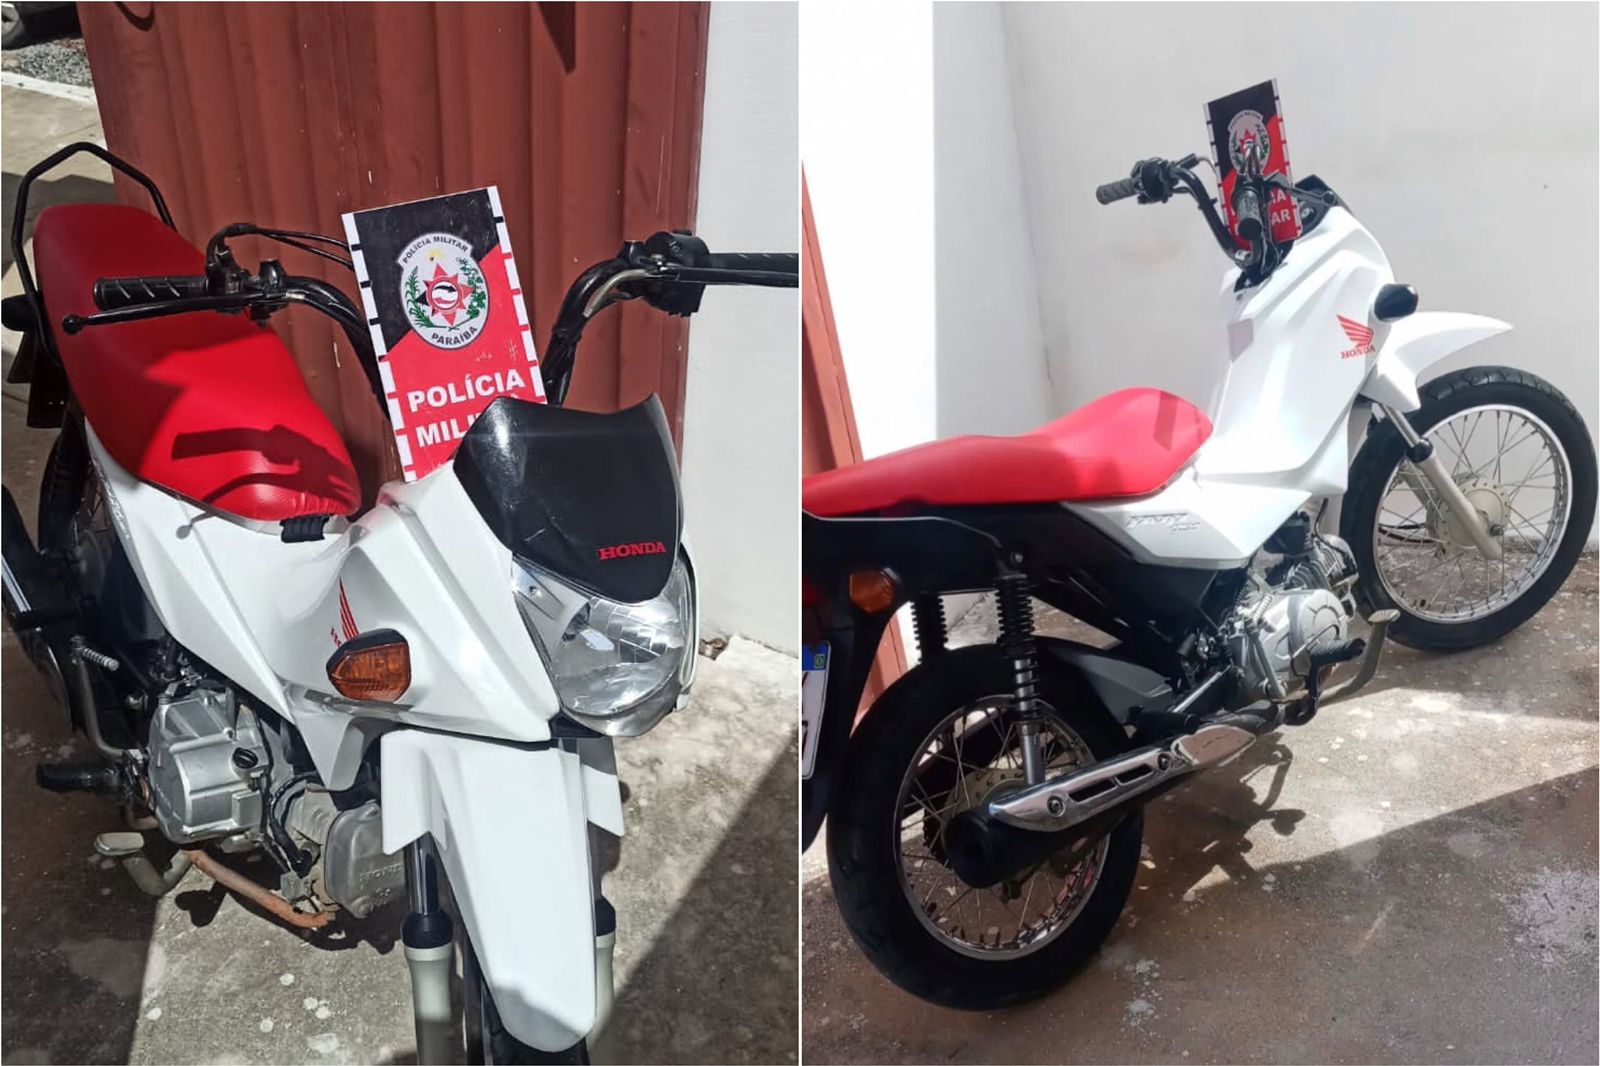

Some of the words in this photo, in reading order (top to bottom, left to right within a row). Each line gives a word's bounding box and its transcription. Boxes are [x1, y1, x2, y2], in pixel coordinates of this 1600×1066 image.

[402, 238, 432, 264] POLÍCIA
[433, 236, 468, 252] MILITAR
[431, 326, 478, 345] PARAÍBA
[1341, 345, 1376, 360] HONDA
[407, 368, 526, 413] POLÍCIA
[415, 412, 482, 448] MILI
[598, 542, 666, 560] HONDA
